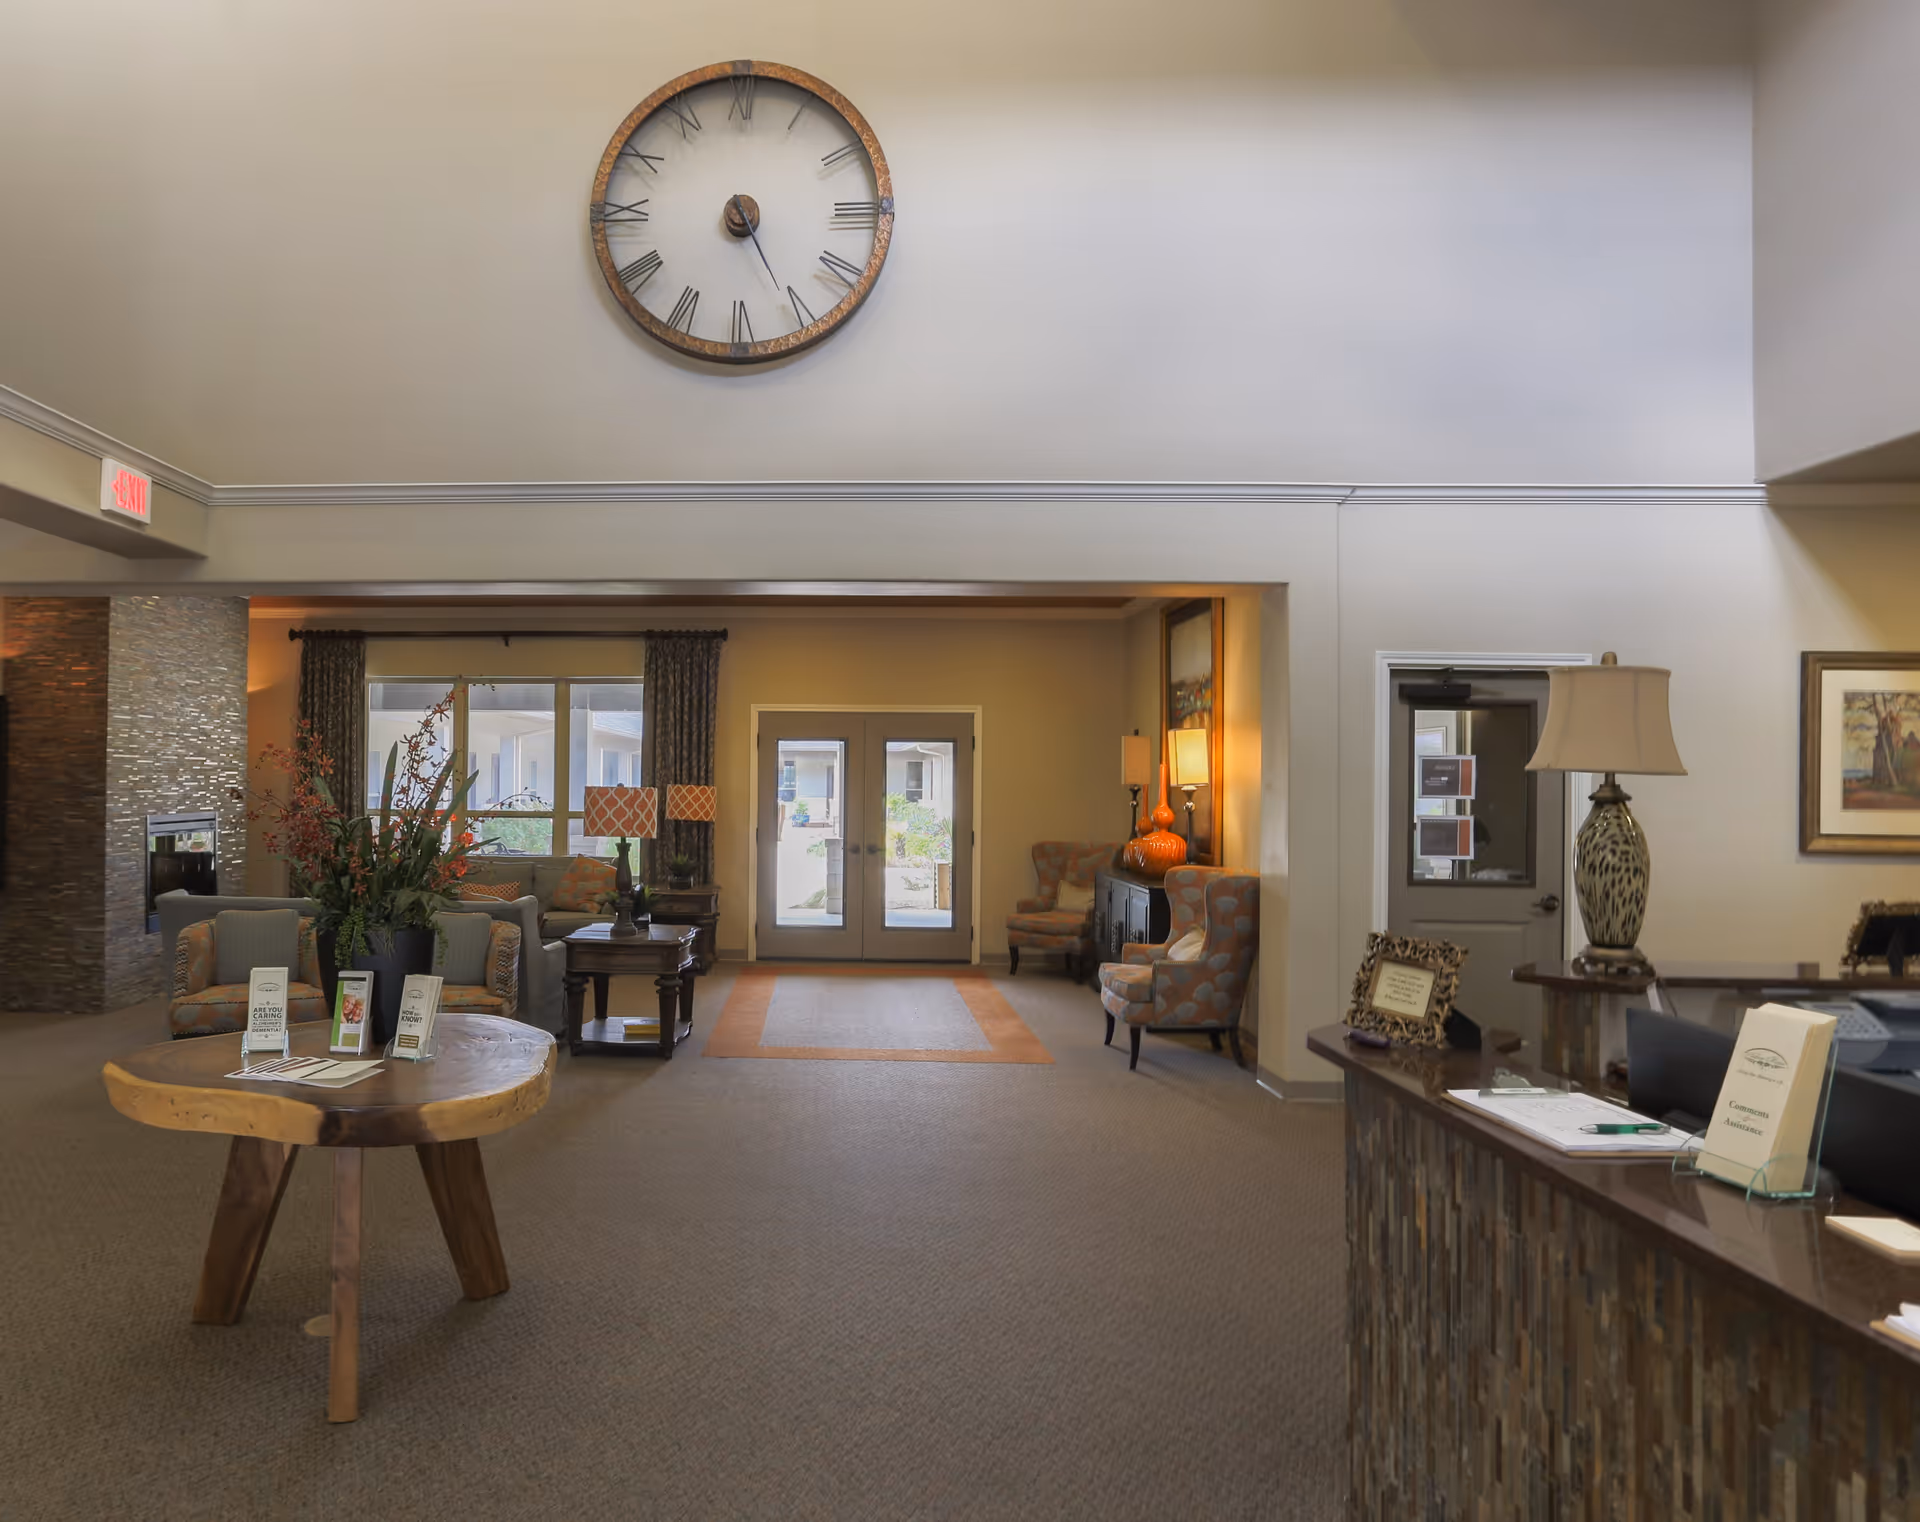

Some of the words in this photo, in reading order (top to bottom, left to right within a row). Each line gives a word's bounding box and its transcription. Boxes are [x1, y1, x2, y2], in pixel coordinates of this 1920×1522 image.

[833, 202, 878, 217] III
[116, 469, 148, 516] EXIT
[401, 1015, 422, 1024] KNOW?
[1729, 1100, 1769, 1119] Comments
[1723, 1117, 1763, 1136] Assistance
